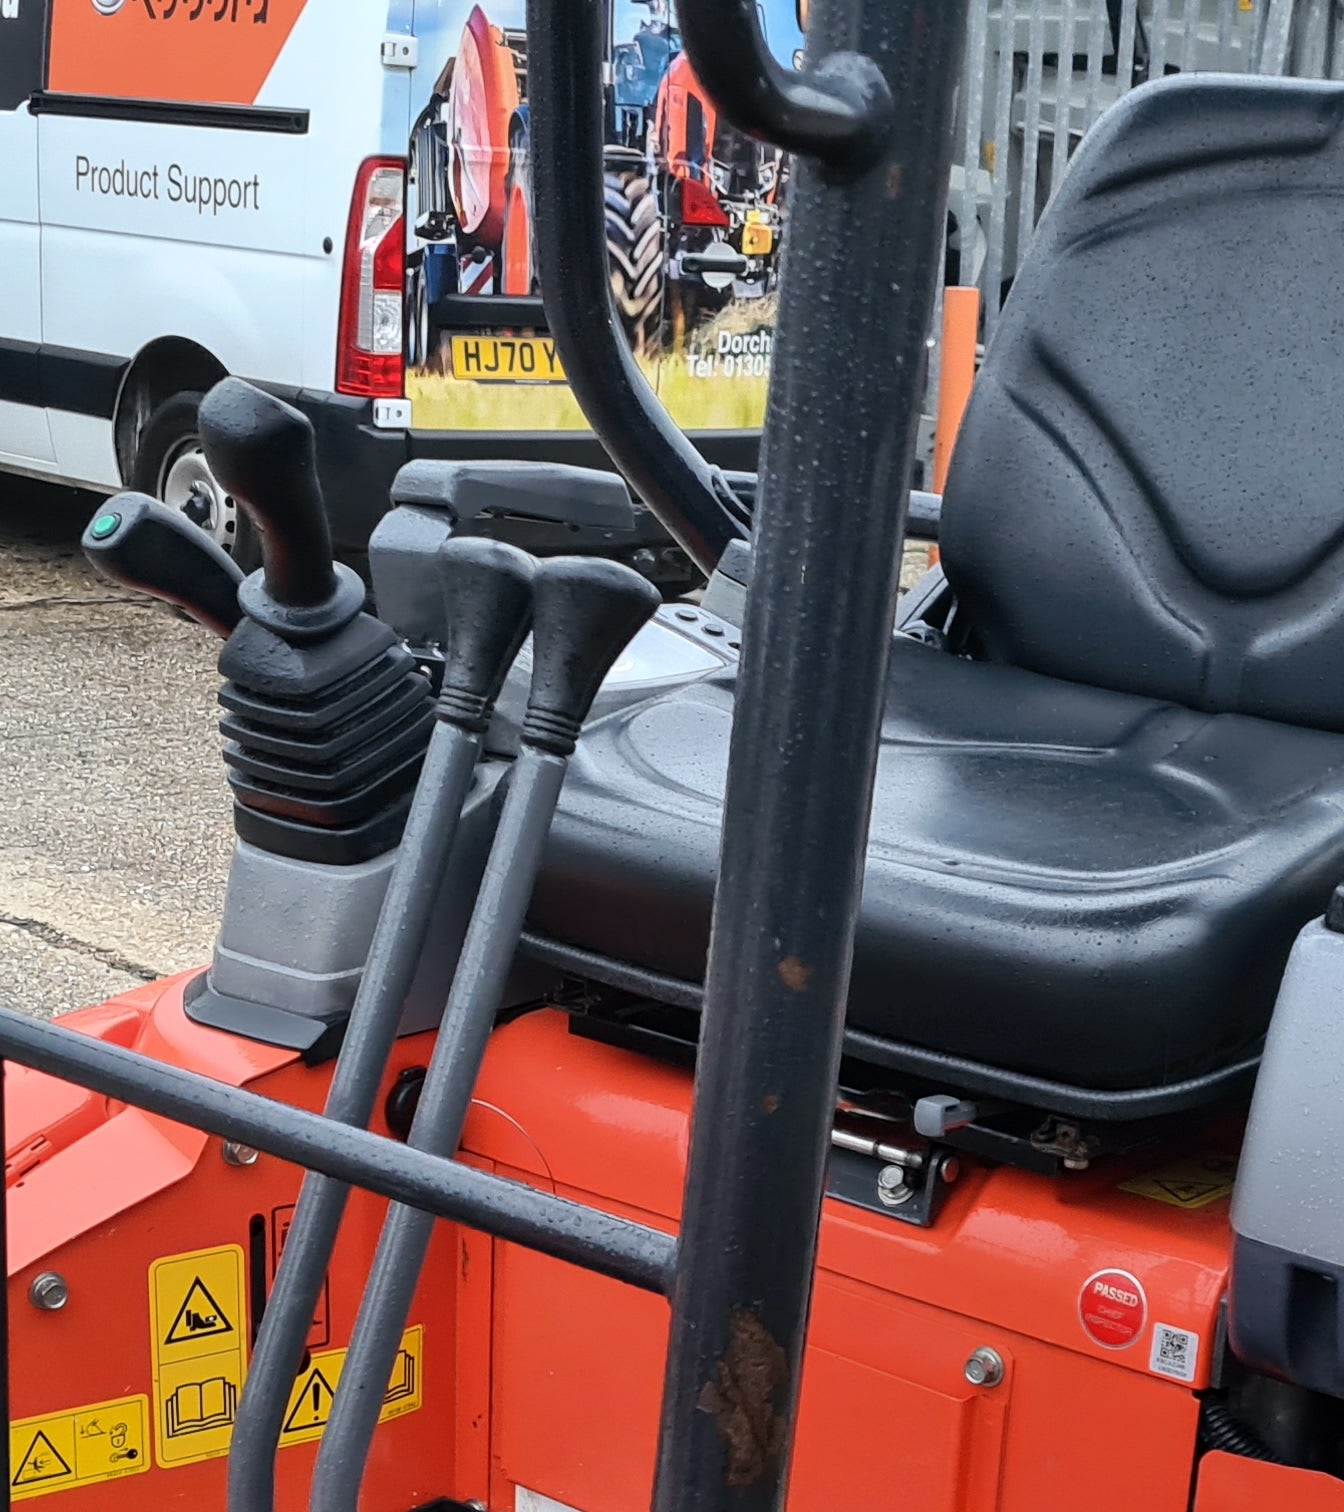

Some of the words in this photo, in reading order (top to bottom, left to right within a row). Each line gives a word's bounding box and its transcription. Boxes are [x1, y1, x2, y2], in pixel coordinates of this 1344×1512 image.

[75, 154, 159, 201] Product
[166, 162, 260, 217] Support
[463, 340, 536, 373] HJ70
[542, 341, 557, 373] Y
[1093, 1281, 1139, 1308] PASSED
